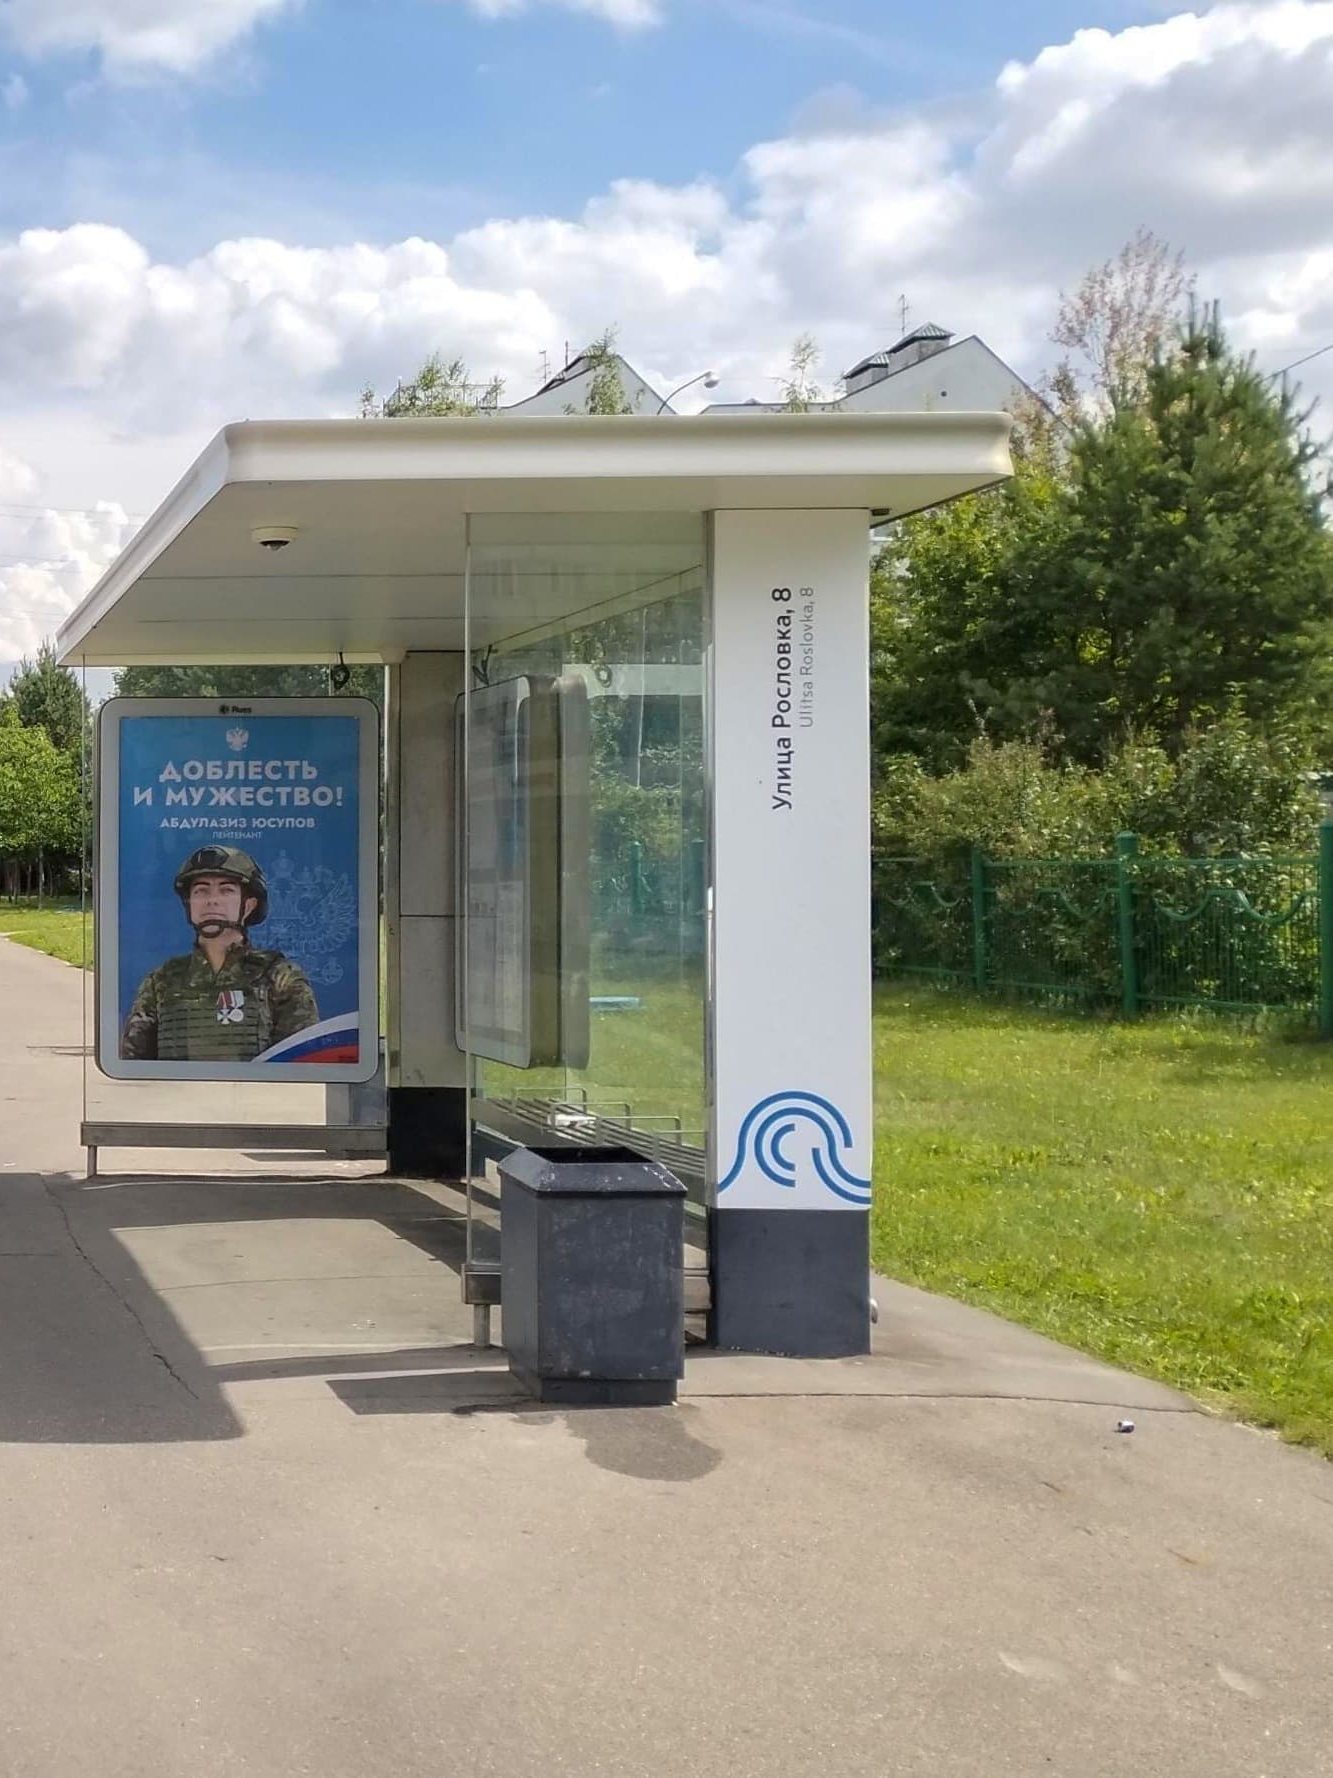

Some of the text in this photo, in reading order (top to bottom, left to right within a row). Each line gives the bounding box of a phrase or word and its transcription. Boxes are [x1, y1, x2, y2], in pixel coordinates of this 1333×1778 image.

[799, 587, 815, 727] Ulitsa Roslovka, 8
[771, 588, 795, 810] Улица Рословка, 8
[159, 760, 318, 783] ДОБЛЕСТЬ
[133, 786, 344, 807] И МУЖЕСТВО!
[159, 816, 316, 830] АБДУЛАЗИЗ ЮСУПОВ
